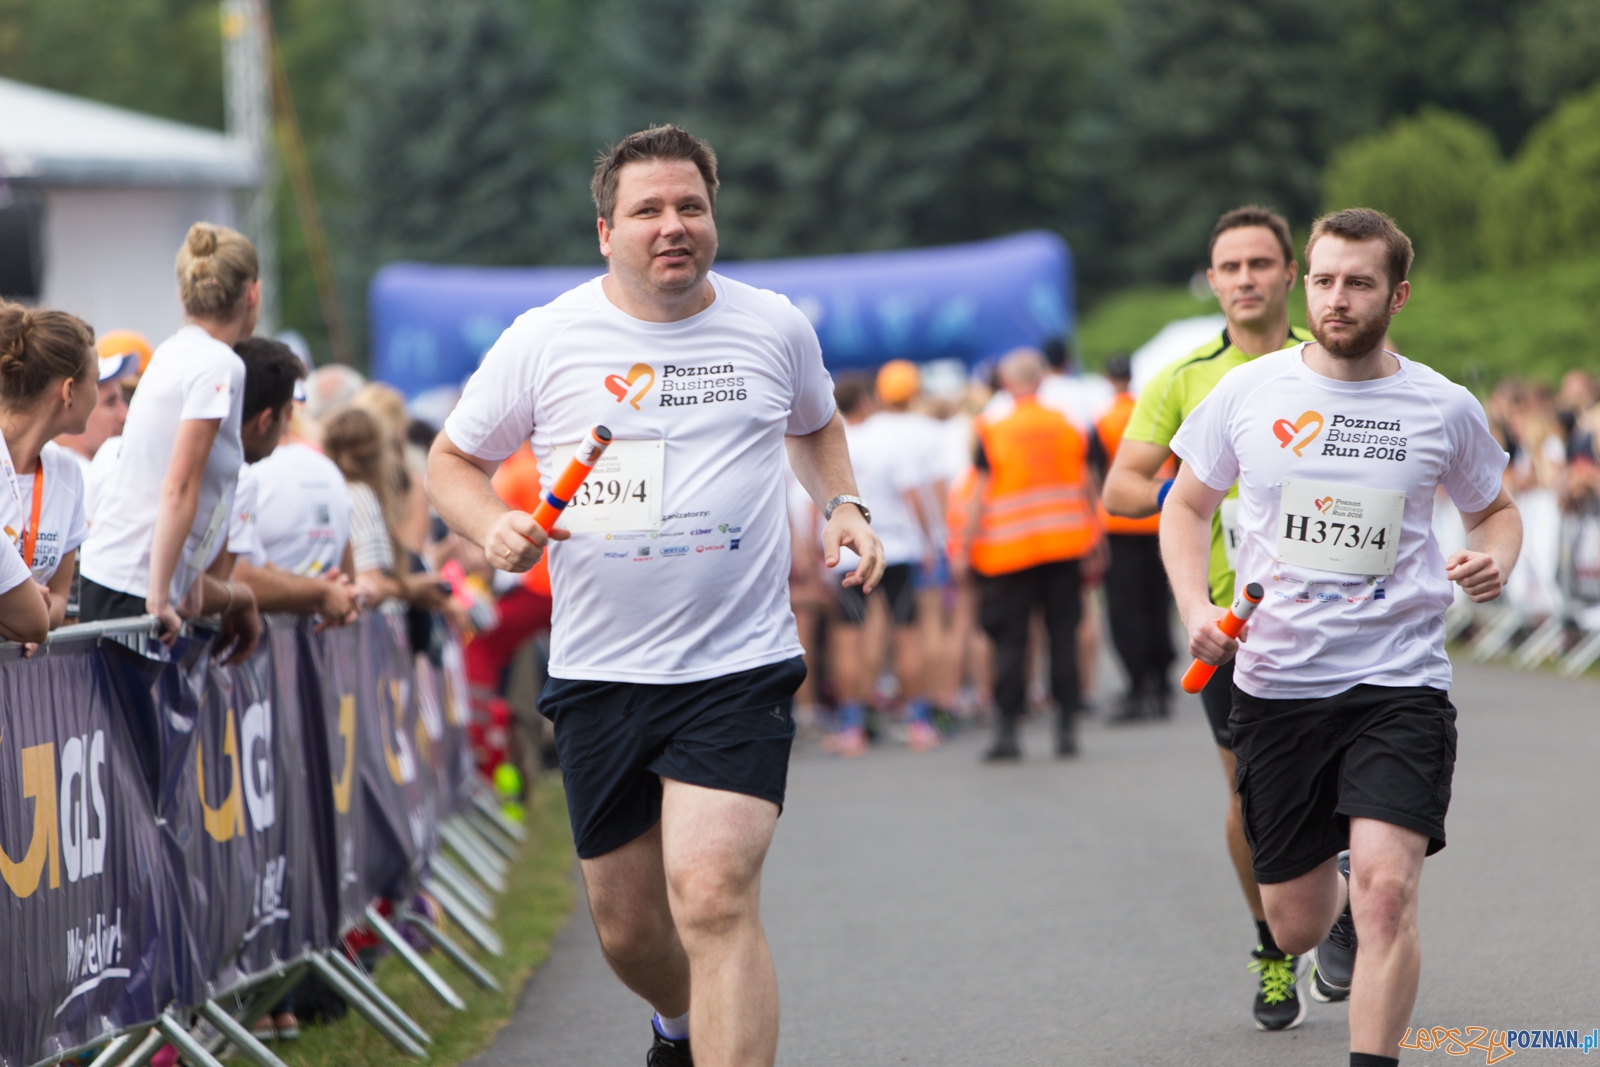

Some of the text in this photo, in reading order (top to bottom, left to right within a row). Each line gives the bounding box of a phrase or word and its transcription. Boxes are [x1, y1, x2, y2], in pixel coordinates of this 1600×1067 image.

[662, 362, 734, 378] Poznań
[661, 376, 745, 392] Business
[659, 389, 747, 407] Run 2016
[1330, 414, 1402, 431] Poznań
[1325, 428, 1408, 447] Business
[1321, 443, 1407, 462] Run 2016
[567, 479, 647, 508] 329/4
[1332, 509, 1363, 519] Run 2016
[690, 528, 713, 536] ciber
[1283, 512, 1386, 550] H373/4
